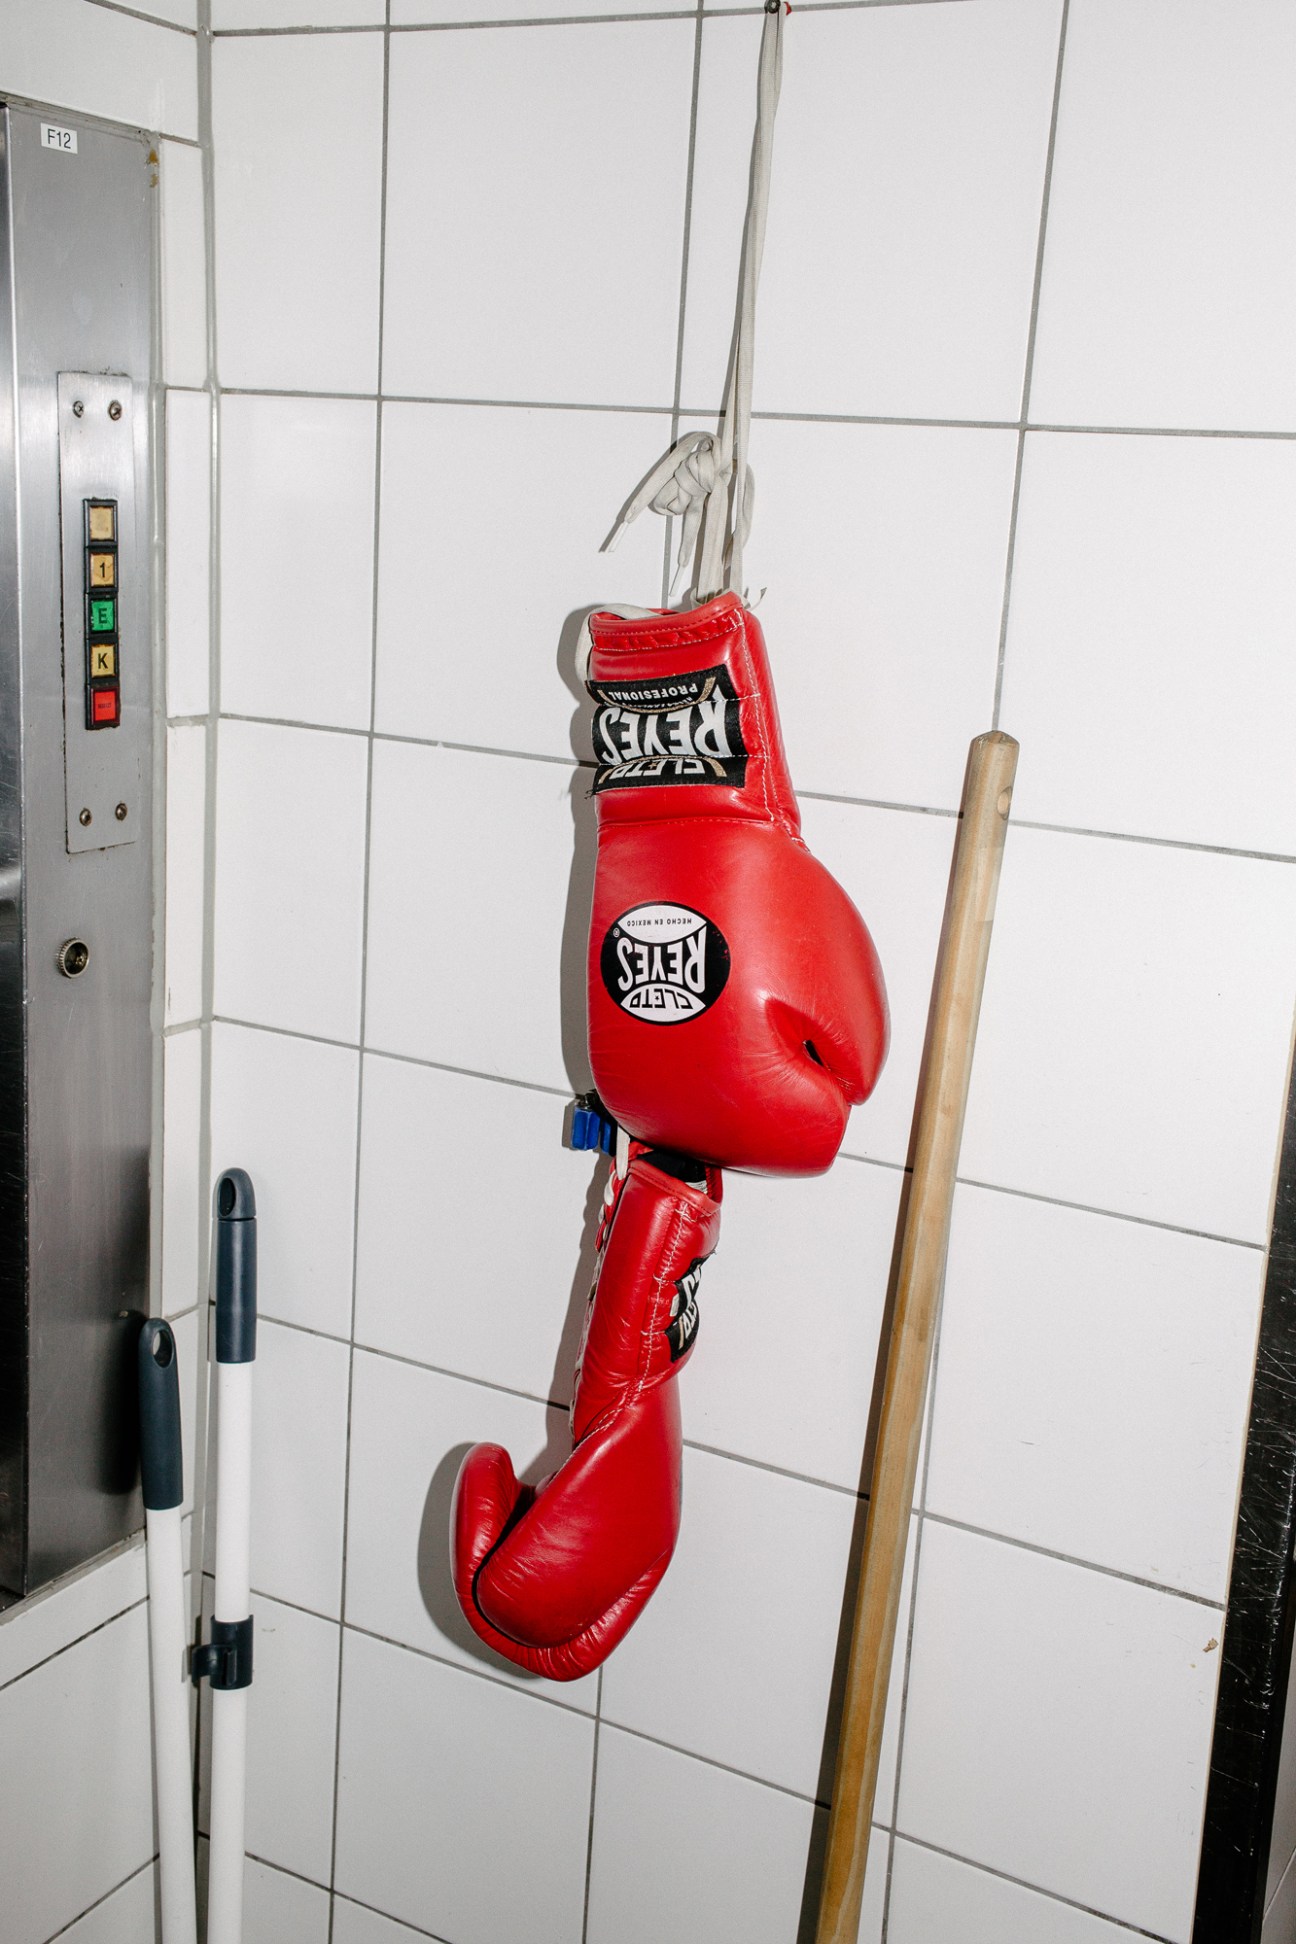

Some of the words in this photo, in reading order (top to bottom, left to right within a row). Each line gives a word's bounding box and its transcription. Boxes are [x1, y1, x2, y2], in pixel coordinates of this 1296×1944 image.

[47, 128, 72, 149] F12
[99, 562, 106, 578] 1
[98, 607, 108, 624] E
[97, 653, 109, 669] K
[608, 683, 698, 700] PROFESIONAL
[599, 684, 733, 766] REYES
[626, 919, 652, 927] MEXICO
[654, 918, 664, 926] EN
[666, 917, 692, 926] HECHO
[616, 925, 707, 993] REYES
[629, 988, 694, 1009] CLETO
